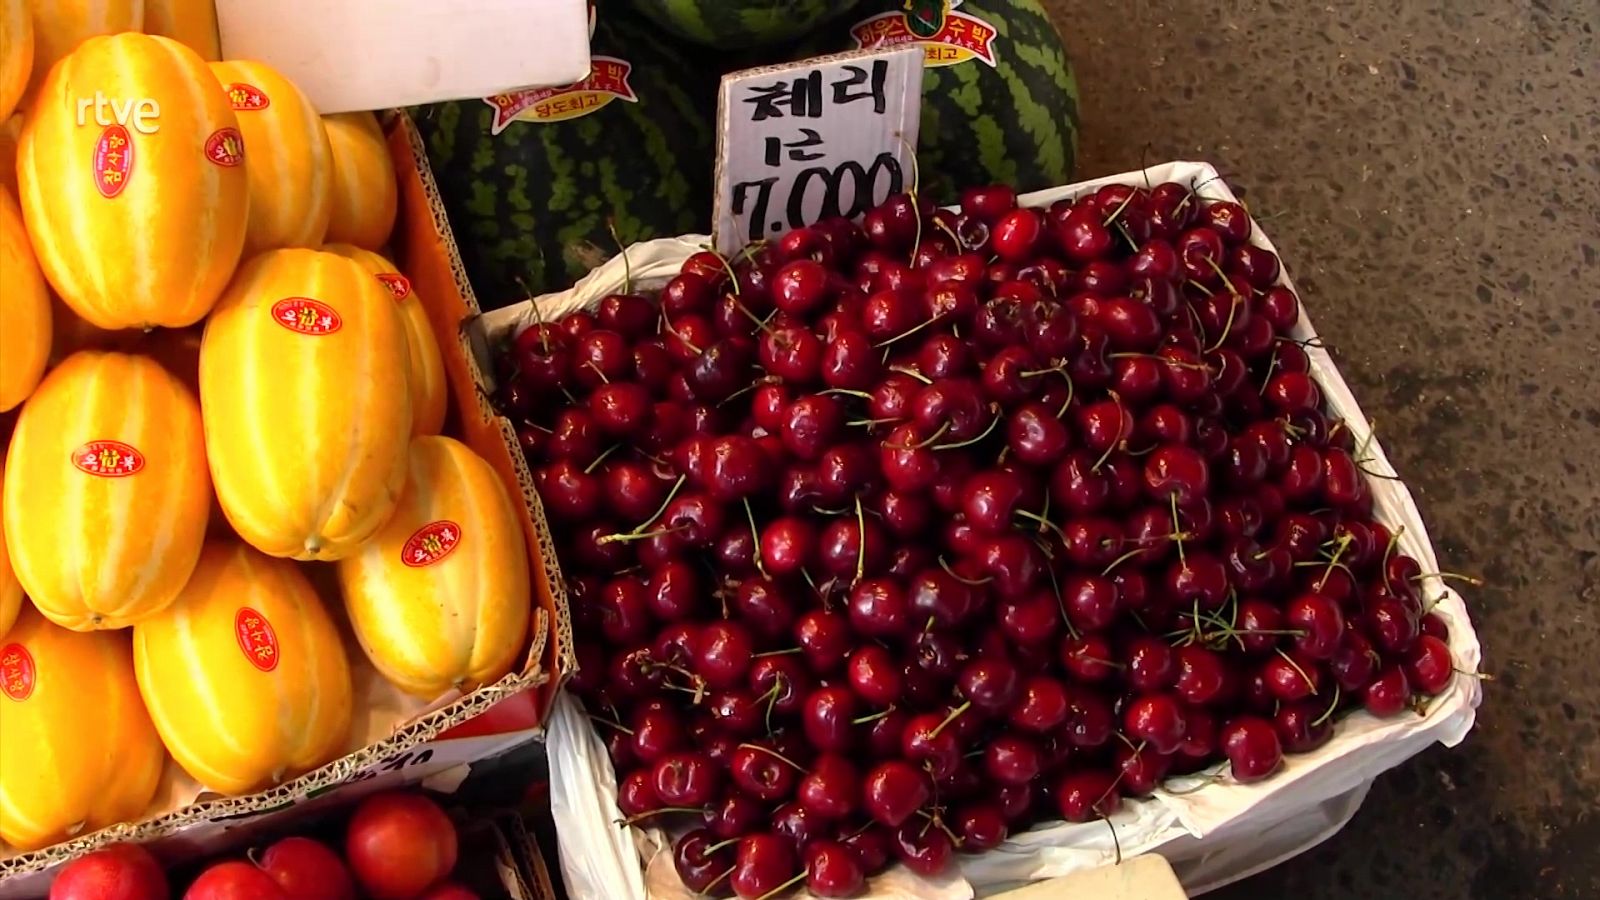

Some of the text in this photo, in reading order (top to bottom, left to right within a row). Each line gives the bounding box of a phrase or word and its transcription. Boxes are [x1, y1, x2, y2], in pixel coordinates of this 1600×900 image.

[949, 18, 988, 46] 수박
[535, 94, 600, 118] 당도최고
[742, 60, 888, 120] 체리
[103, 134, 126, 185] 참사랑
[732, 152, 903, 240] 7.000
